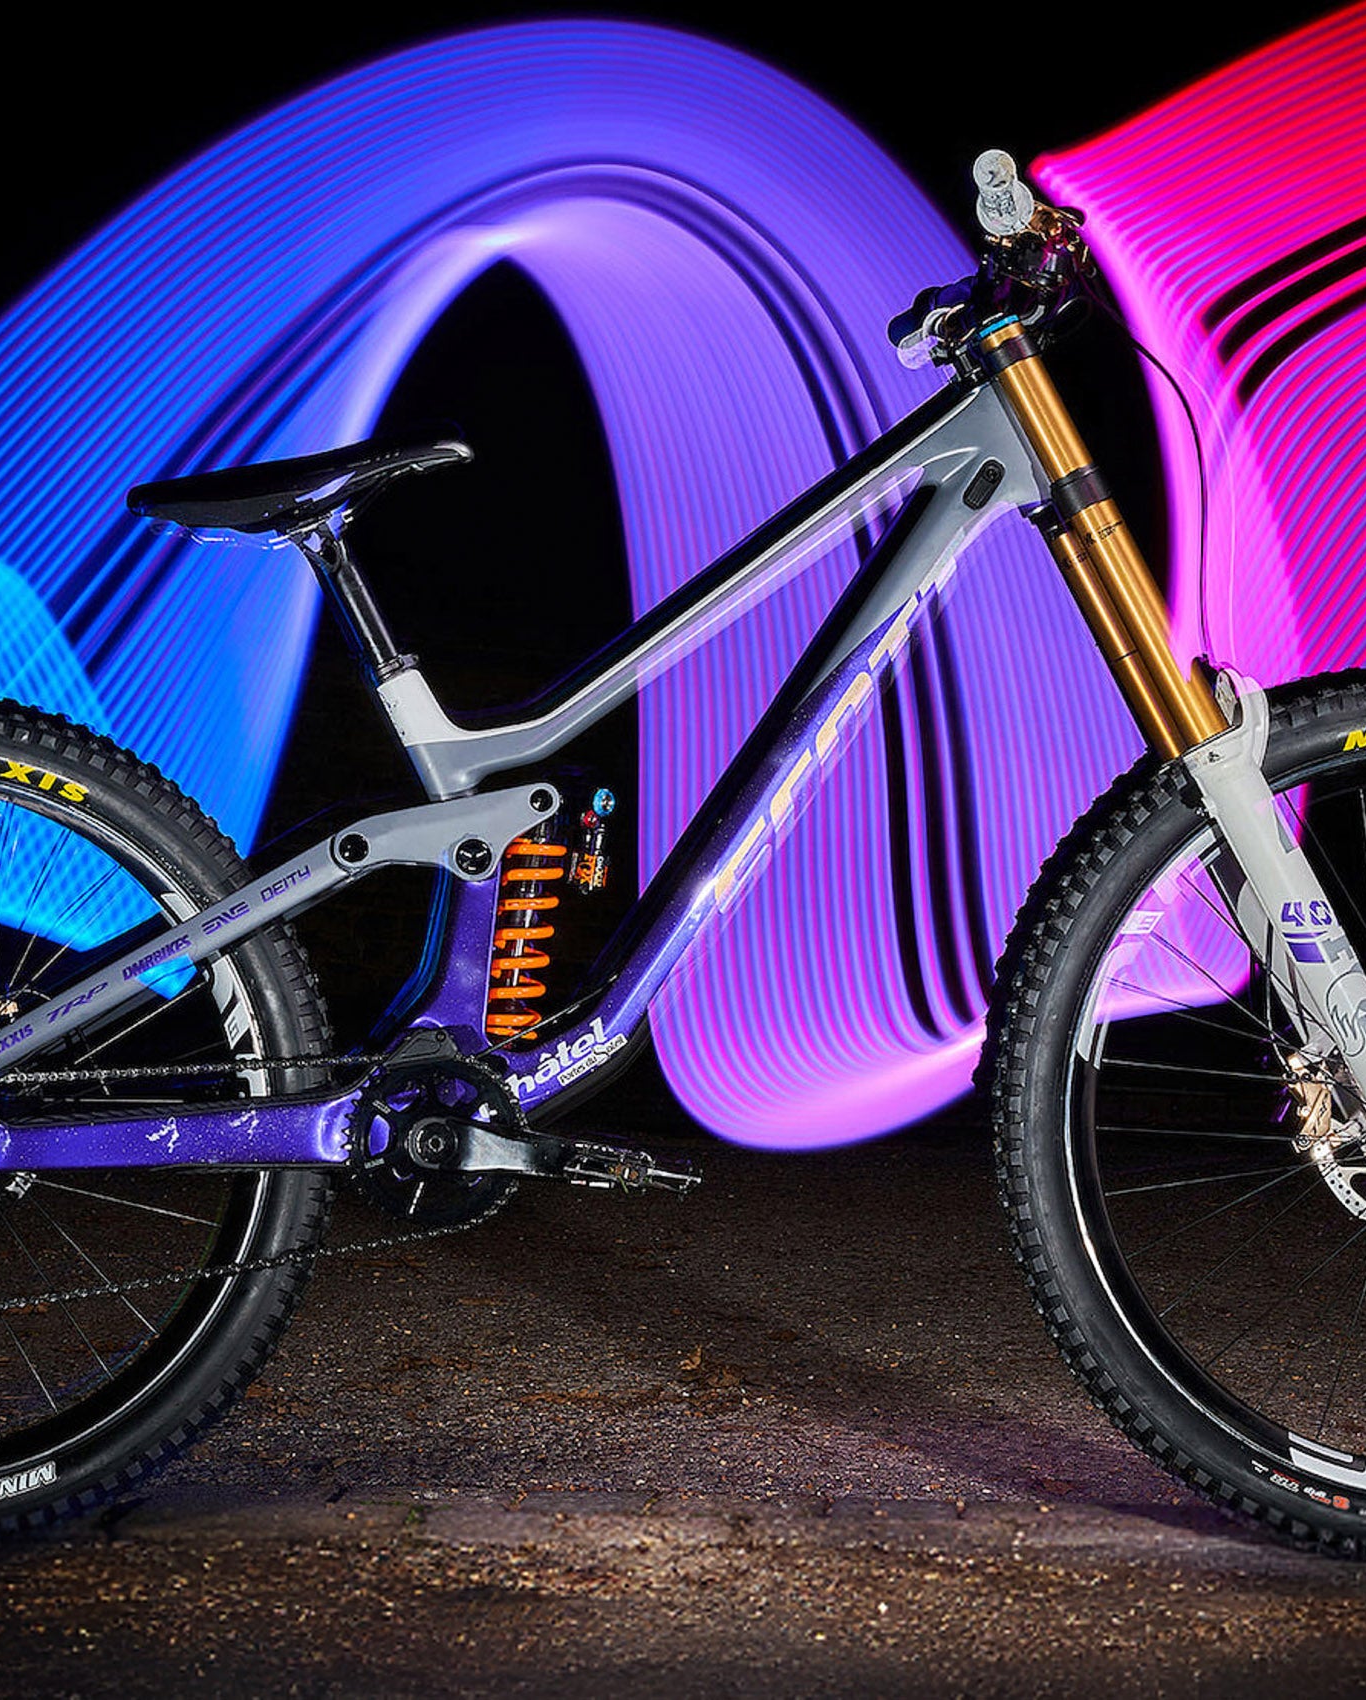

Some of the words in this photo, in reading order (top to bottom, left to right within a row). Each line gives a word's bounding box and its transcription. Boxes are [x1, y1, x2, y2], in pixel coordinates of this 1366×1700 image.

[47, 982, 108, 1024] TRP
[260, 865, 311, 903] DEITY
[1281, 900, 1332, 927] 40
